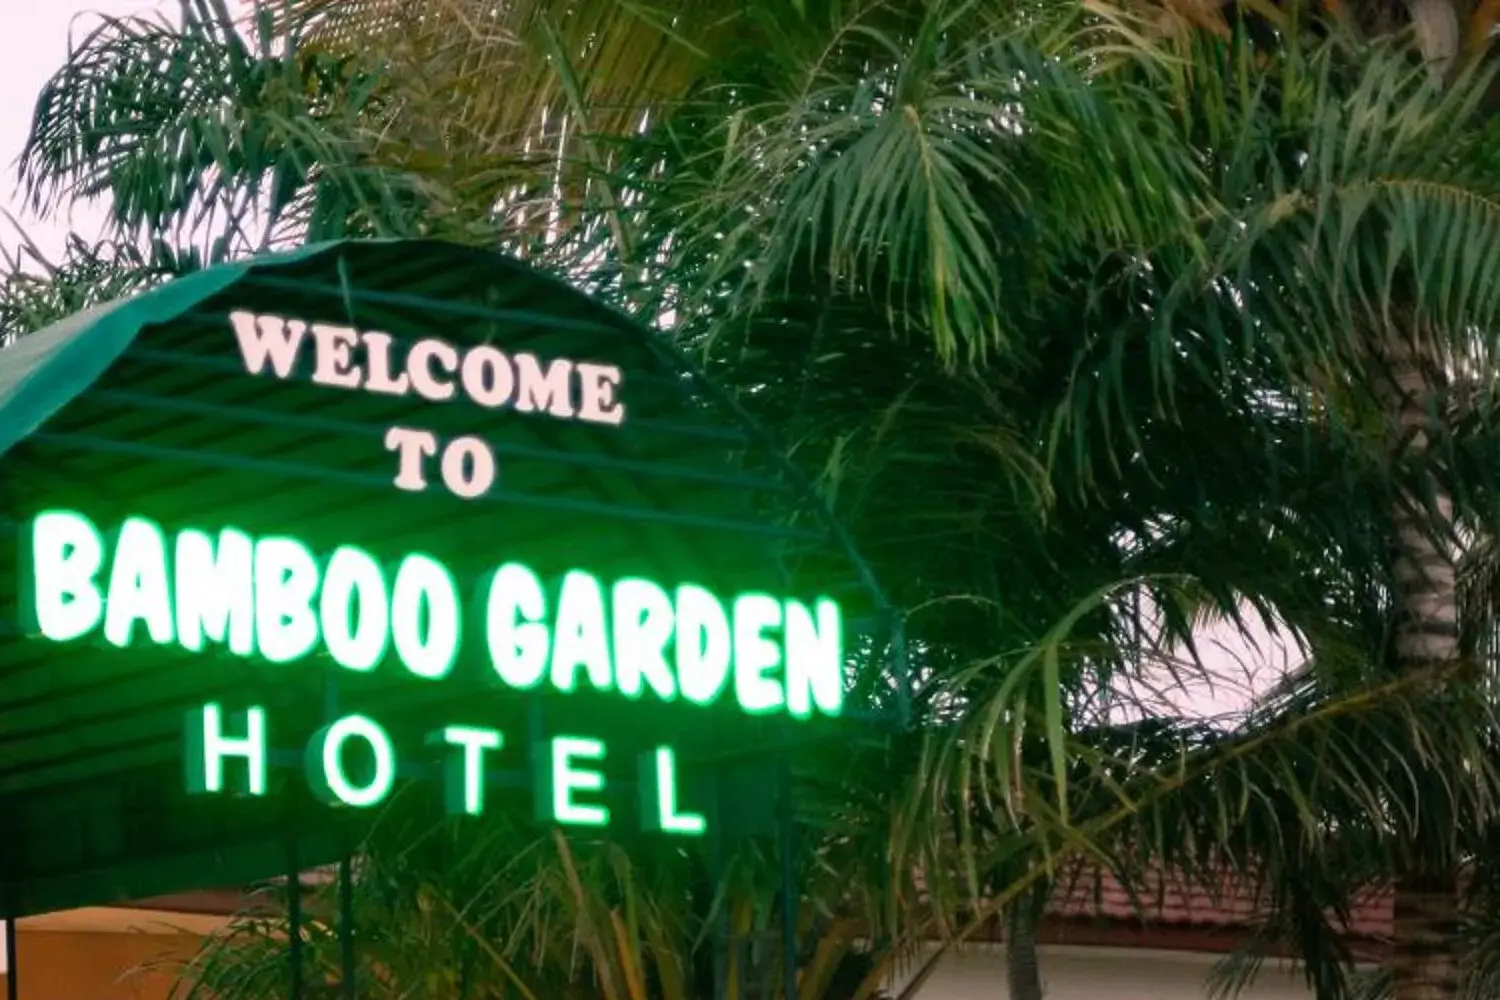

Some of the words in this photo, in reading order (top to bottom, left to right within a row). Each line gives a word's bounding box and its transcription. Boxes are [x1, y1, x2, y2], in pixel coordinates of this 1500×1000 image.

[230, 310, 625, 425] WELCOME
[384, 426, 496, 498] TO
[32, 509, 460, 681] BAMBOO
[486, 561, 844, 718] GARDEN
[202, 702, 707, 834] HOTEL
